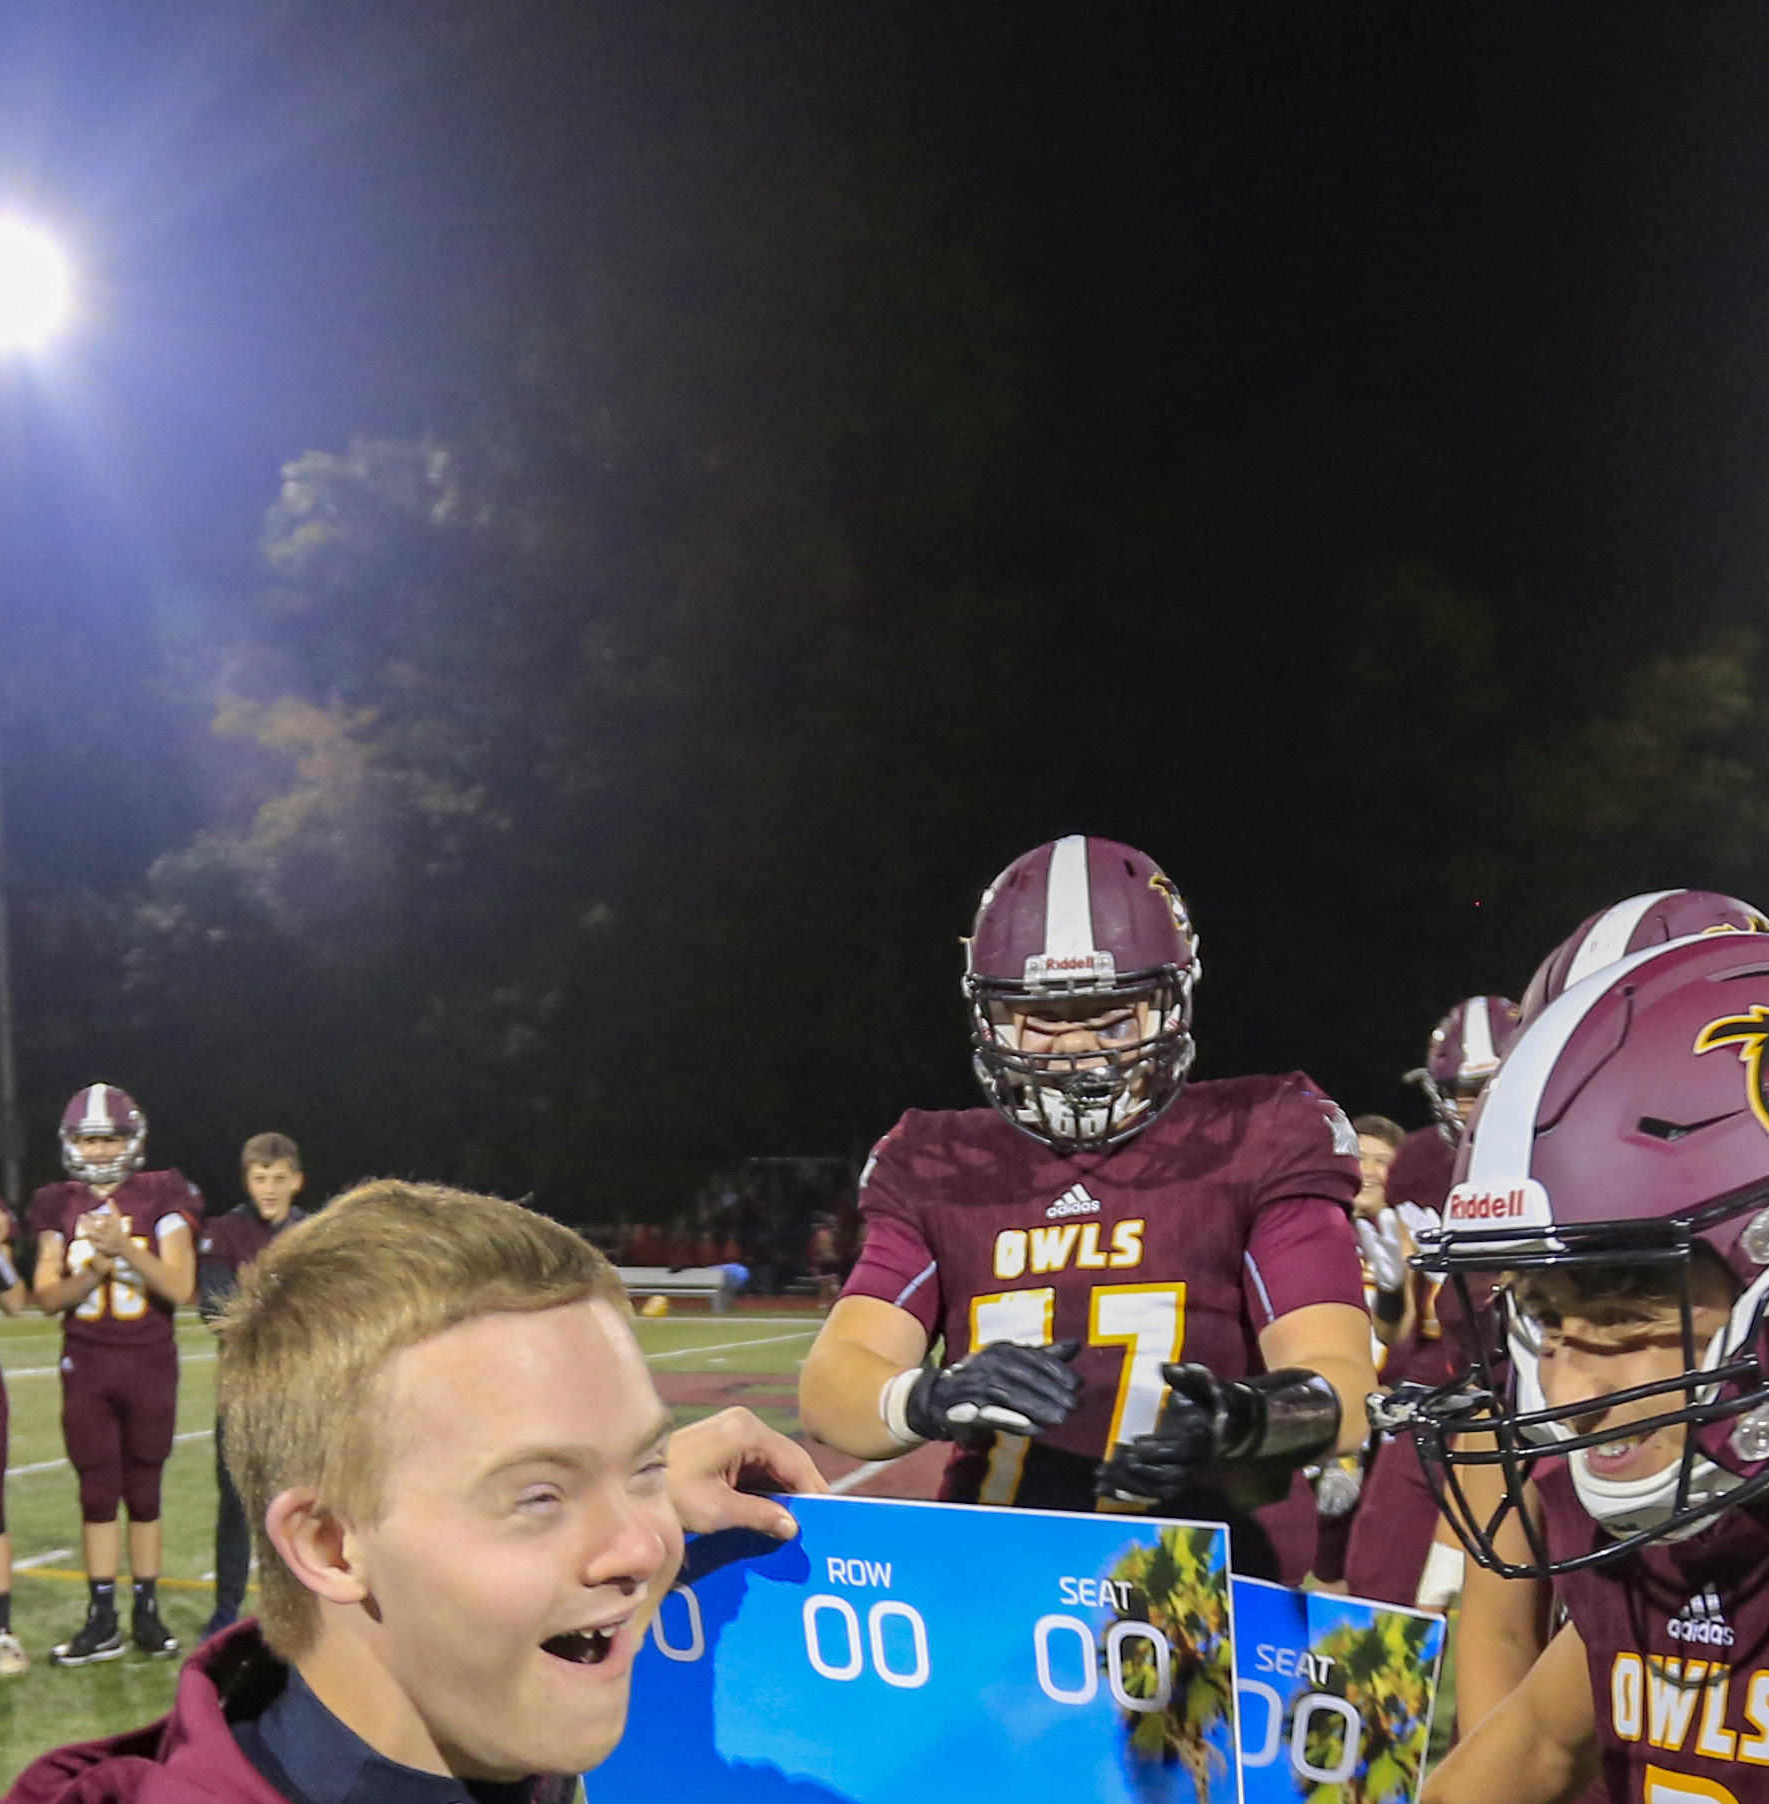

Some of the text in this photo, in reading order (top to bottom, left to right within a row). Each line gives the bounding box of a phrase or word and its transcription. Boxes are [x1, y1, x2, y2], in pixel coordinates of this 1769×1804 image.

[1045, 956, 1095, 971] Riddell
[1045, 1198, 1102, 1219] adidas
[1449, 1189, 1526, 1220] Riddell
[993, 1218, 1147, 1281] OWLS
[826, 1556, 892, 1589] ROW
[1058, 1575, 1135, 1611] SEAT
[801, 1592, 931, 1691] 00
[1665, 1616, 1736, 1647] adidas
[1033, 1612, 1173, 1713] 00
[1255, 1643, 1337, 1686] SEAT
